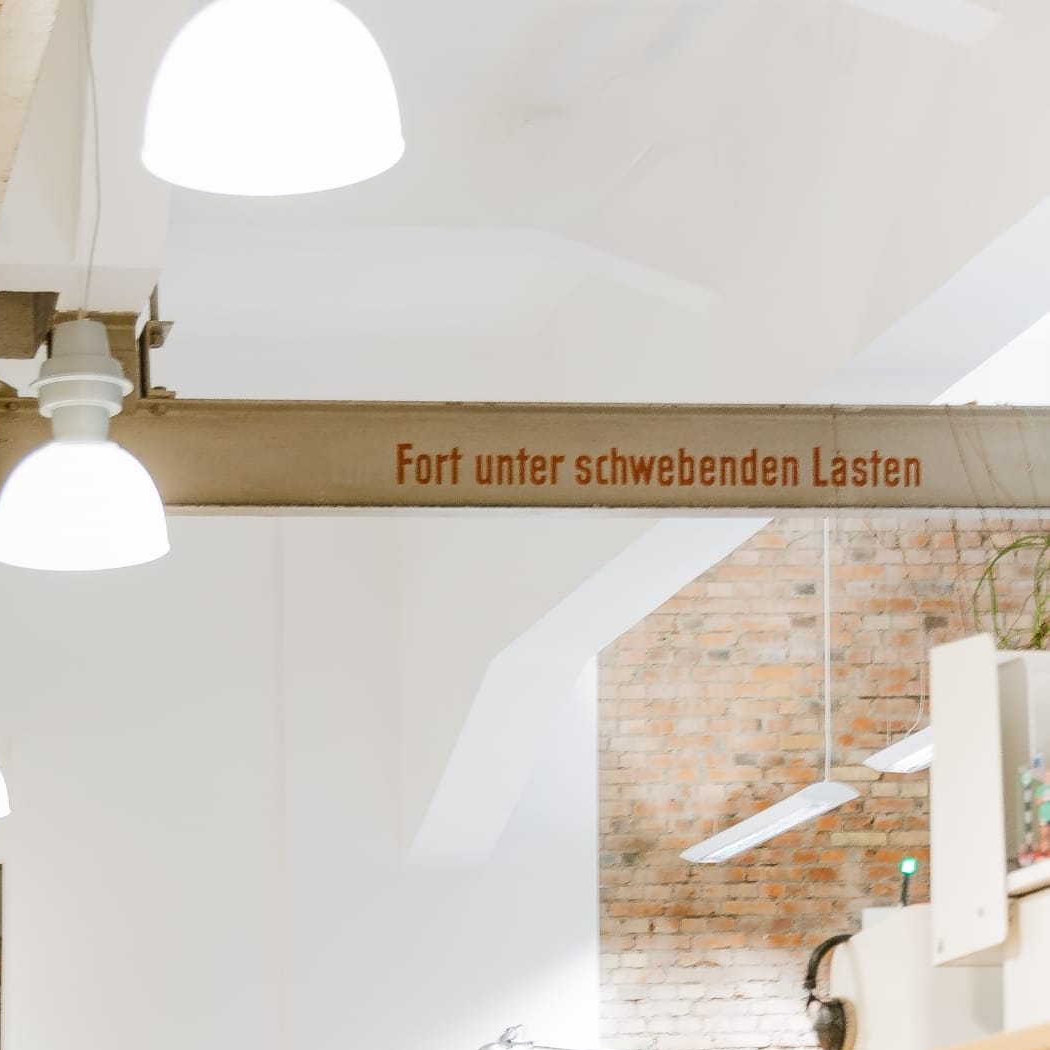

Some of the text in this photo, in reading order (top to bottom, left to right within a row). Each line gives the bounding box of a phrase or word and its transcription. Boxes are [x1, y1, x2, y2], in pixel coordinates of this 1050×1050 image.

[395, 442, 921, 488] Fort unter schwebenden Lasten
